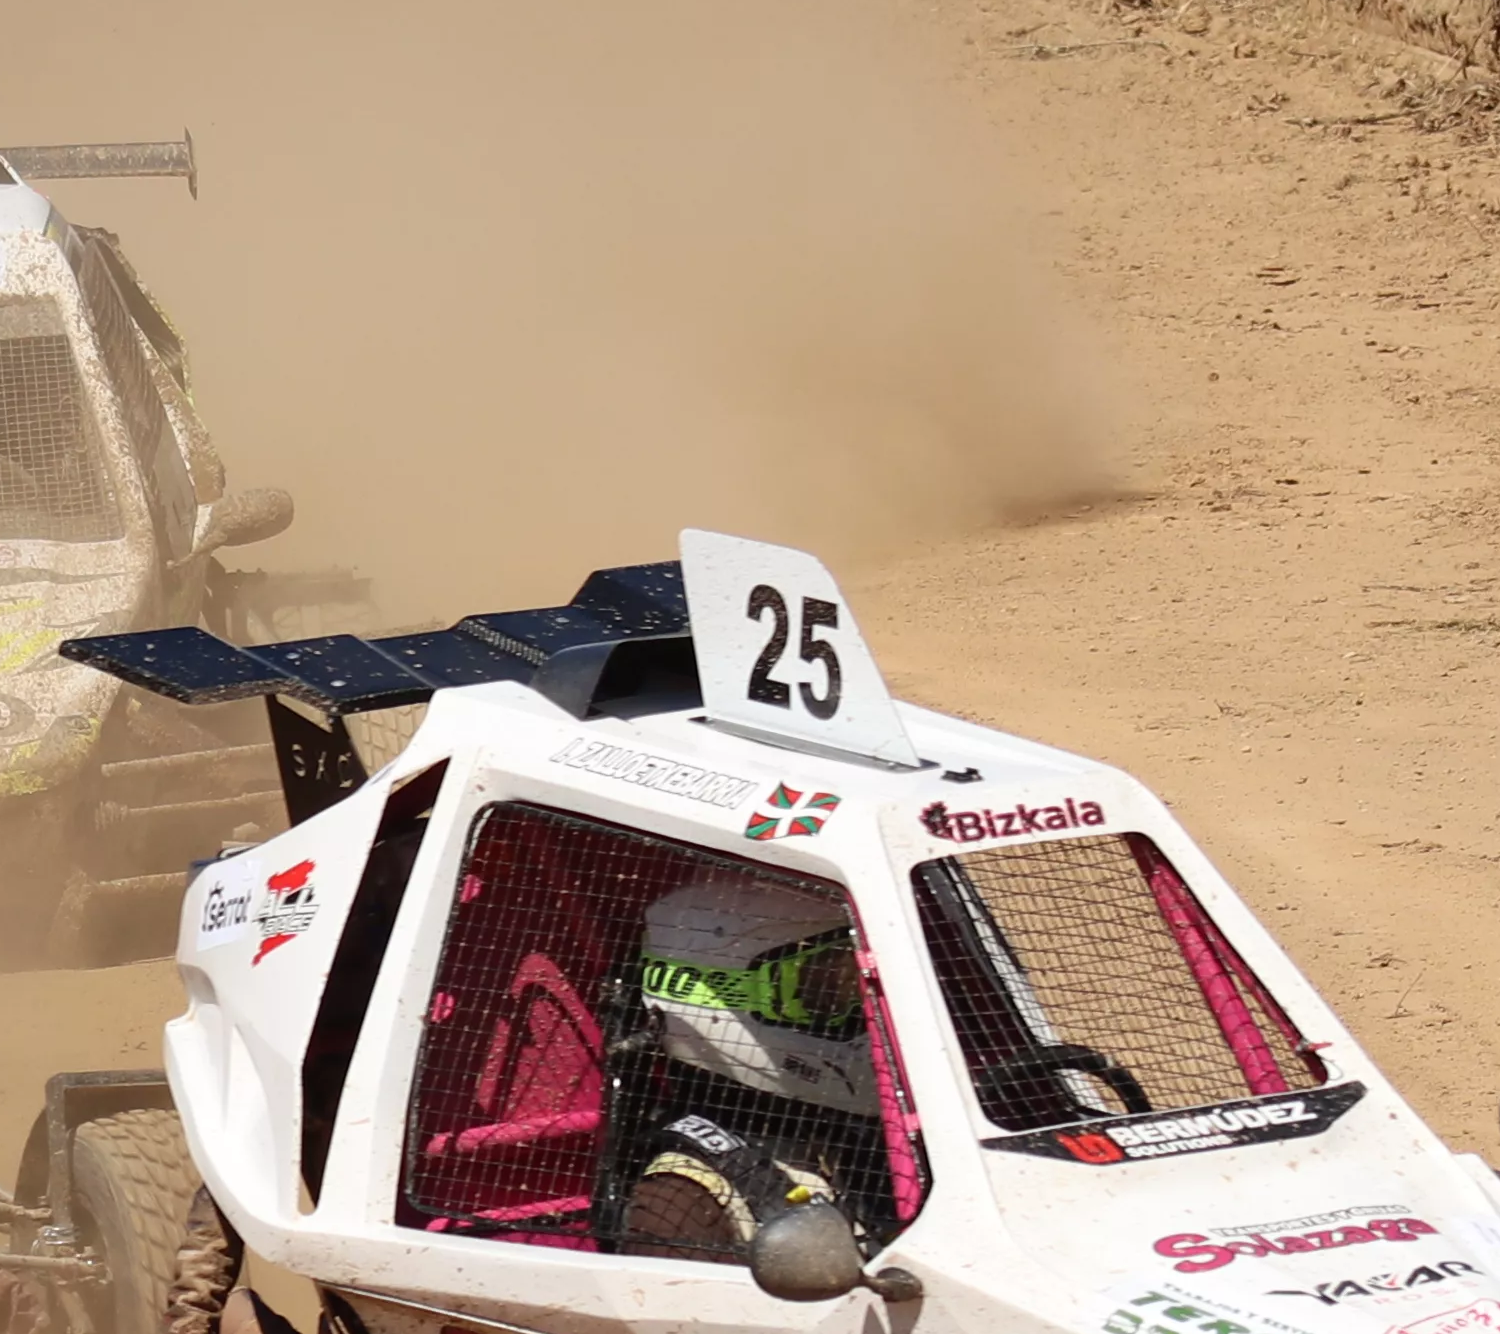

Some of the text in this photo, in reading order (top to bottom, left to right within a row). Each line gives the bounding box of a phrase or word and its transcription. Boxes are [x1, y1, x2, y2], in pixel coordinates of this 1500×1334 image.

[747, 584, 842, 721] 25
[1105, 1099, 1319, 1148] BERMÚDEZ
[1125, 1134, 1235, 1158] SOLUTIONS
